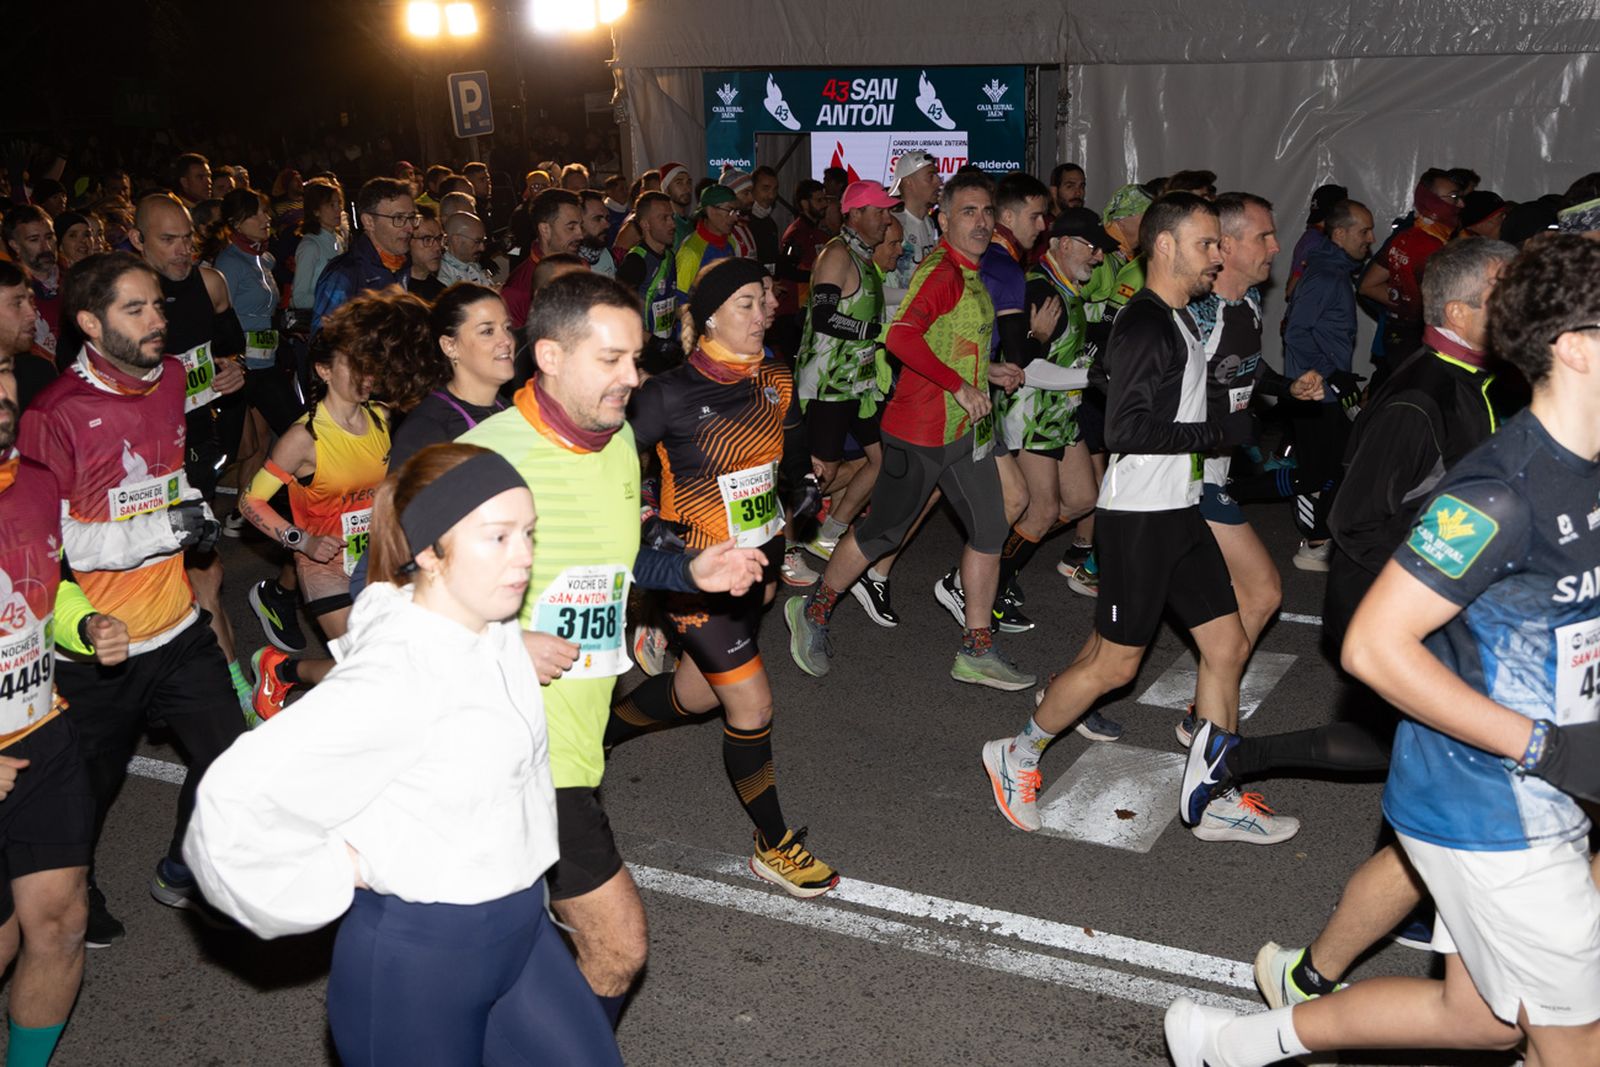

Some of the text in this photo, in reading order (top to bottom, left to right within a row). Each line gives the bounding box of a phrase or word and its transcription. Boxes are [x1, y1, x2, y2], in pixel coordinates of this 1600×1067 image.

[821, 78, 898, 103] 43 SAN
[458, 79, 482, 129] P
[816, 98, 895, 126] ANTÓN
[927, 103, 943, 120] 43
[774, 105, 789, 121] 43
[709, 157, 751, 167] calderón
[971, 160, 1020, 170] calderón
[186, 366, 208, 389] 00
[739, 476, 762, 488] NOCHE
[129, 491, 153, 502] NOCHE
[154, 487, 163, 496] DE
[732, 490, 749, 501] SAN
[120, 505, 137, 516] SAN
[351, 525, 367, 535] SAN
[598, 578, 608, 589] DE
[549, 592, 573, 604] SAN
[1, 602, 27, 630] 43
[557, 605, 617, 640] 3158
[1, 634, 40, 659] NOCHE DE
[1571, 651, 1591, 668] SAN
[0, 652, 51, 701] 4449
